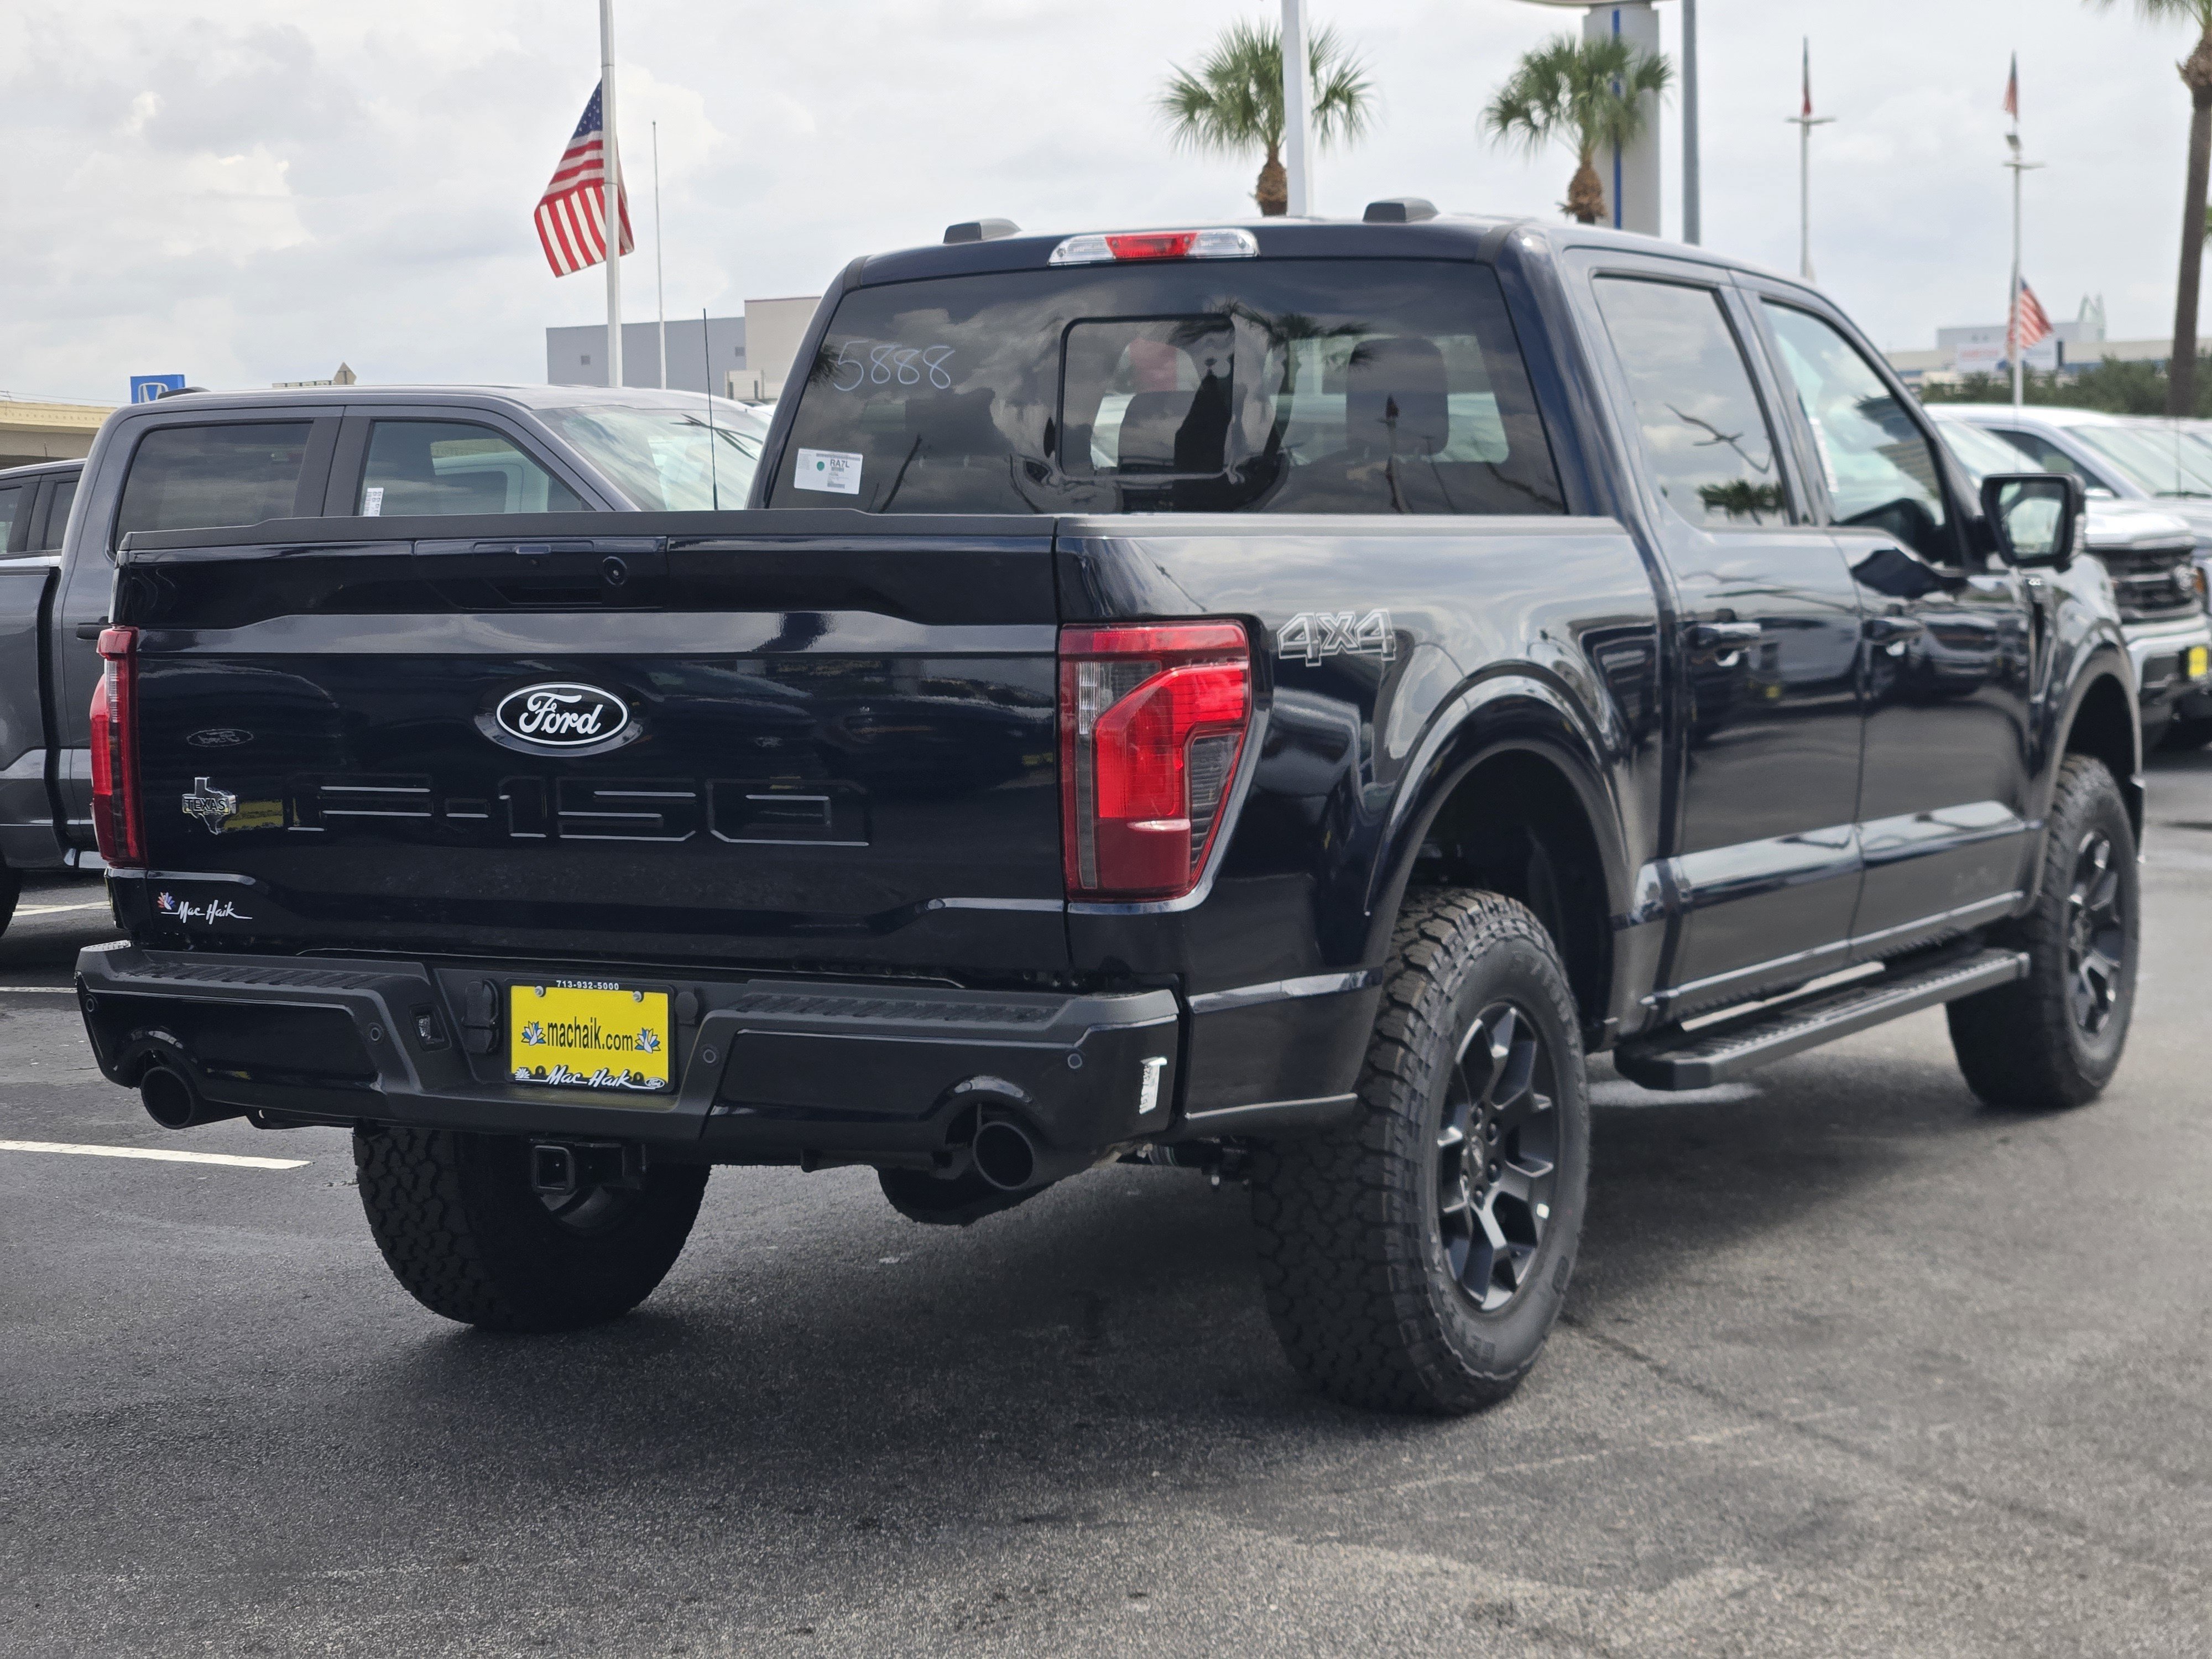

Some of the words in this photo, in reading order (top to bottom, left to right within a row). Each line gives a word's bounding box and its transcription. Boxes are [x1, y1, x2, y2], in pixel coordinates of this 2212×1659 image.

[833, 340, 956, 392] 5888
[519, 692, 603, 734] Ford
[184, 798, 227, 812] TEXAS
[285, 772, 872, 847] F-150
[166, 901, 206, 924] Mac
[206, 899, 249, 925] Haik
[556, 980, 619, 990] 713-932-5000
[547, 1016, 634, 1051] machaik.com
[525, 1065, 587, 1085] Mac
[588, 1068, 650, 1089] Haik
